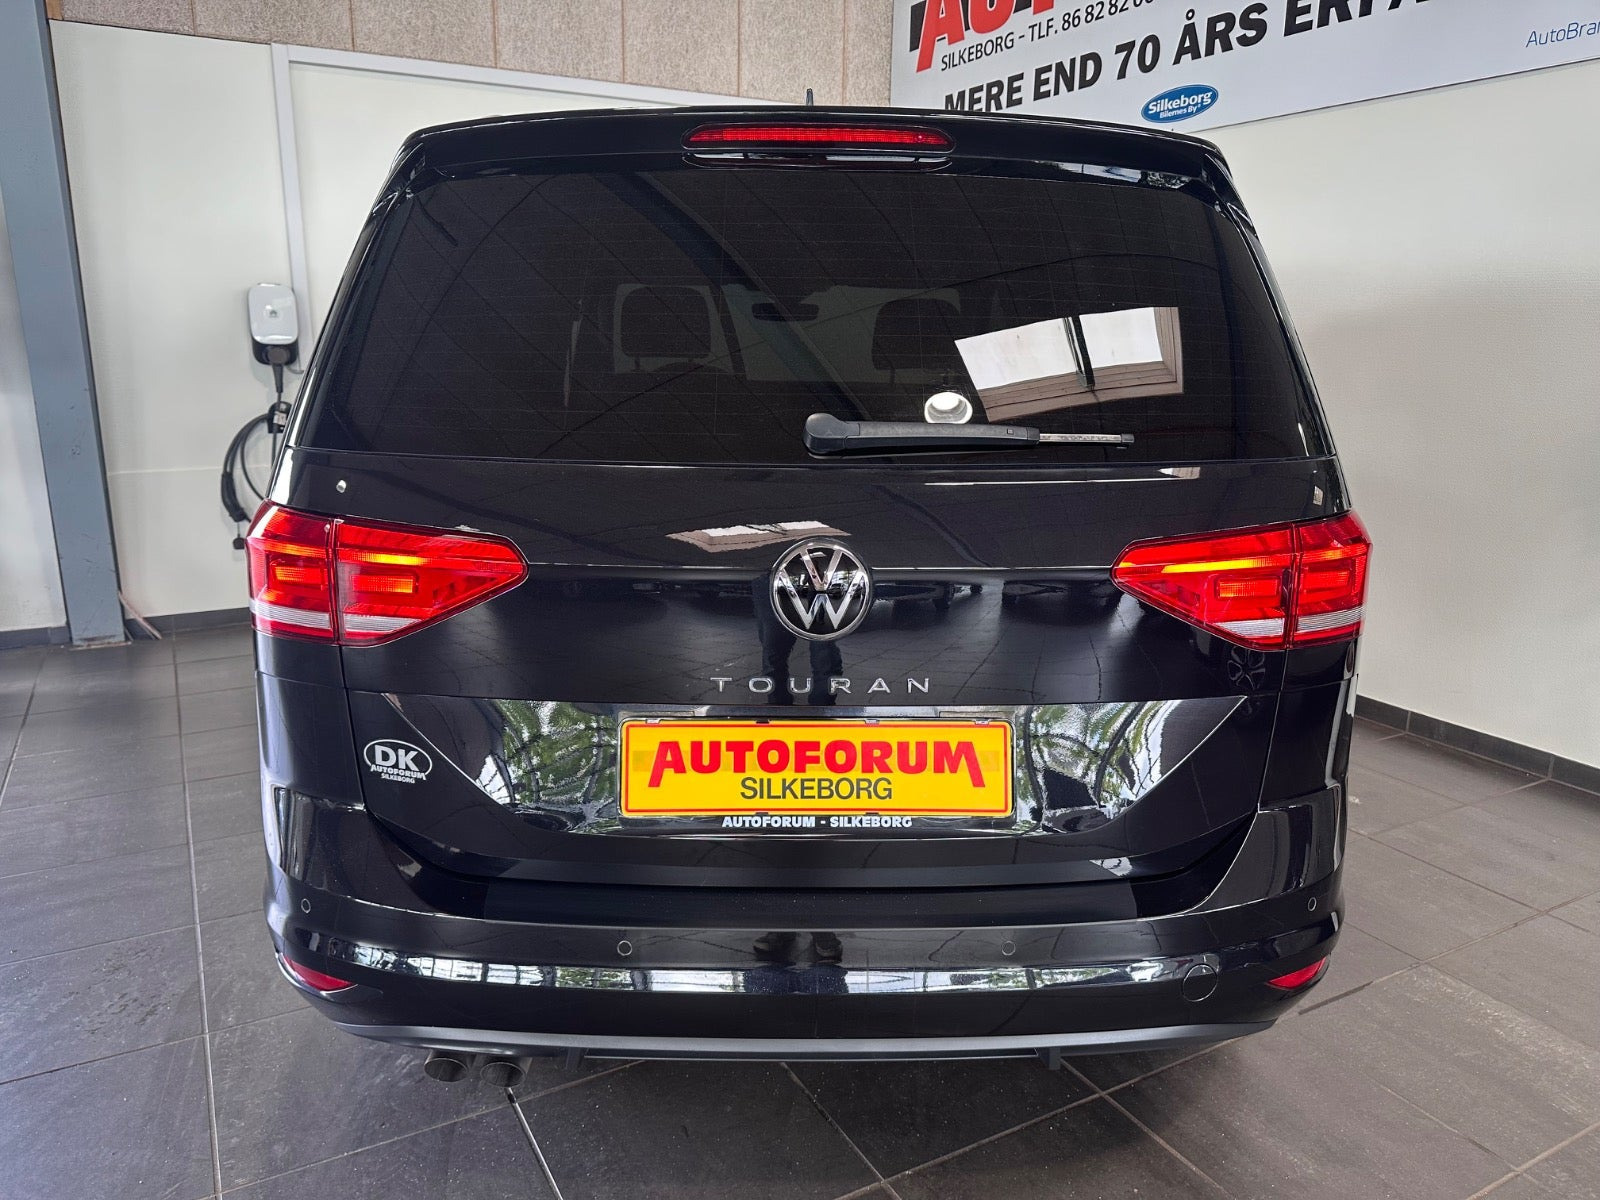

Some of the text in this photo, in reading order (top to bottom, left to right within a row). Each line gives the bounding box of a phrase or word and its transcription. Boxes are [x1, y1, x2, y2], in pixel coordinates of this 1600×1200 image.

[941, 31, 1015, 71] SILKEBORG
[1028, 17, 1058, 43] TLF.
[1061, 8, 1081, 31] 86
[1084, 1, 1105, 24] 82
[944, 72, 1024, 112] MERE
[1033, 51, 1103, 101] END
[1114, 34, 1161, 80] 70
[1172, 3, 1267, 66] ÅRS
[1148, 91, 1213, 114] Silkeborg
[710, 676, 931, 695] TOURAN
[374, 744, 420, 771] DK
[648, 739, 985, 788] AUTOFORUM
[370, 764, 427, 780] AUTOFORUM
[380, 772, 416, 784] SILKEBORG
[740, 776, 893, 800] SILKEBORG
[721, 816, 816, 828] AUTOFORUM
[829, 816, 913, 828] SILKEBORG
